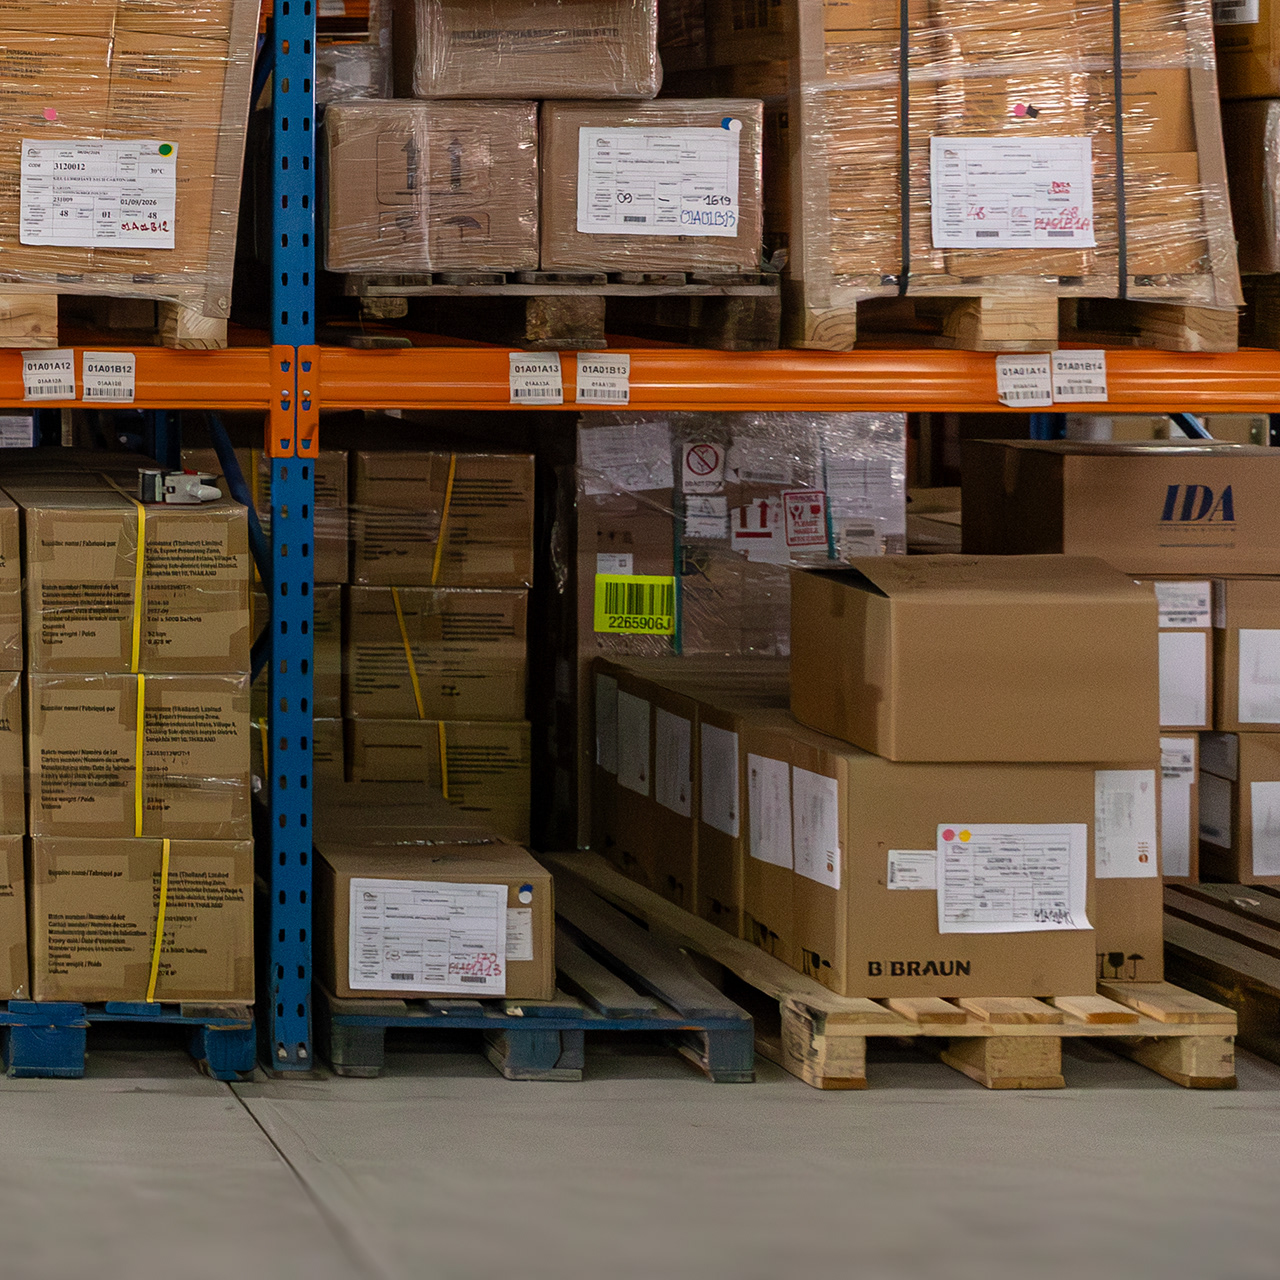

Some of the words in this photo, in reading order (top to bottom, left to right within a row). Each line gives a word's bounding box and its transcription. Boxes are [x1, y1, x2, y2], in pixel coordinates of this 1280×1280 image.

[54, 161, 86, 172] 3120012
[120, 198, 158, 208] 01/09/2026
[27, 362, 71, 371] 01A01A12
[88, 364, 132, 373] 01A01B12
[514, 365, 559, 373] 01A01A13
[582, 365, 627, 374] 01A01B13
[1161, 484, 1236, 522] IDA
[868, 960, 882, 977] B
[890, 960, 971, 977] BRAUN
